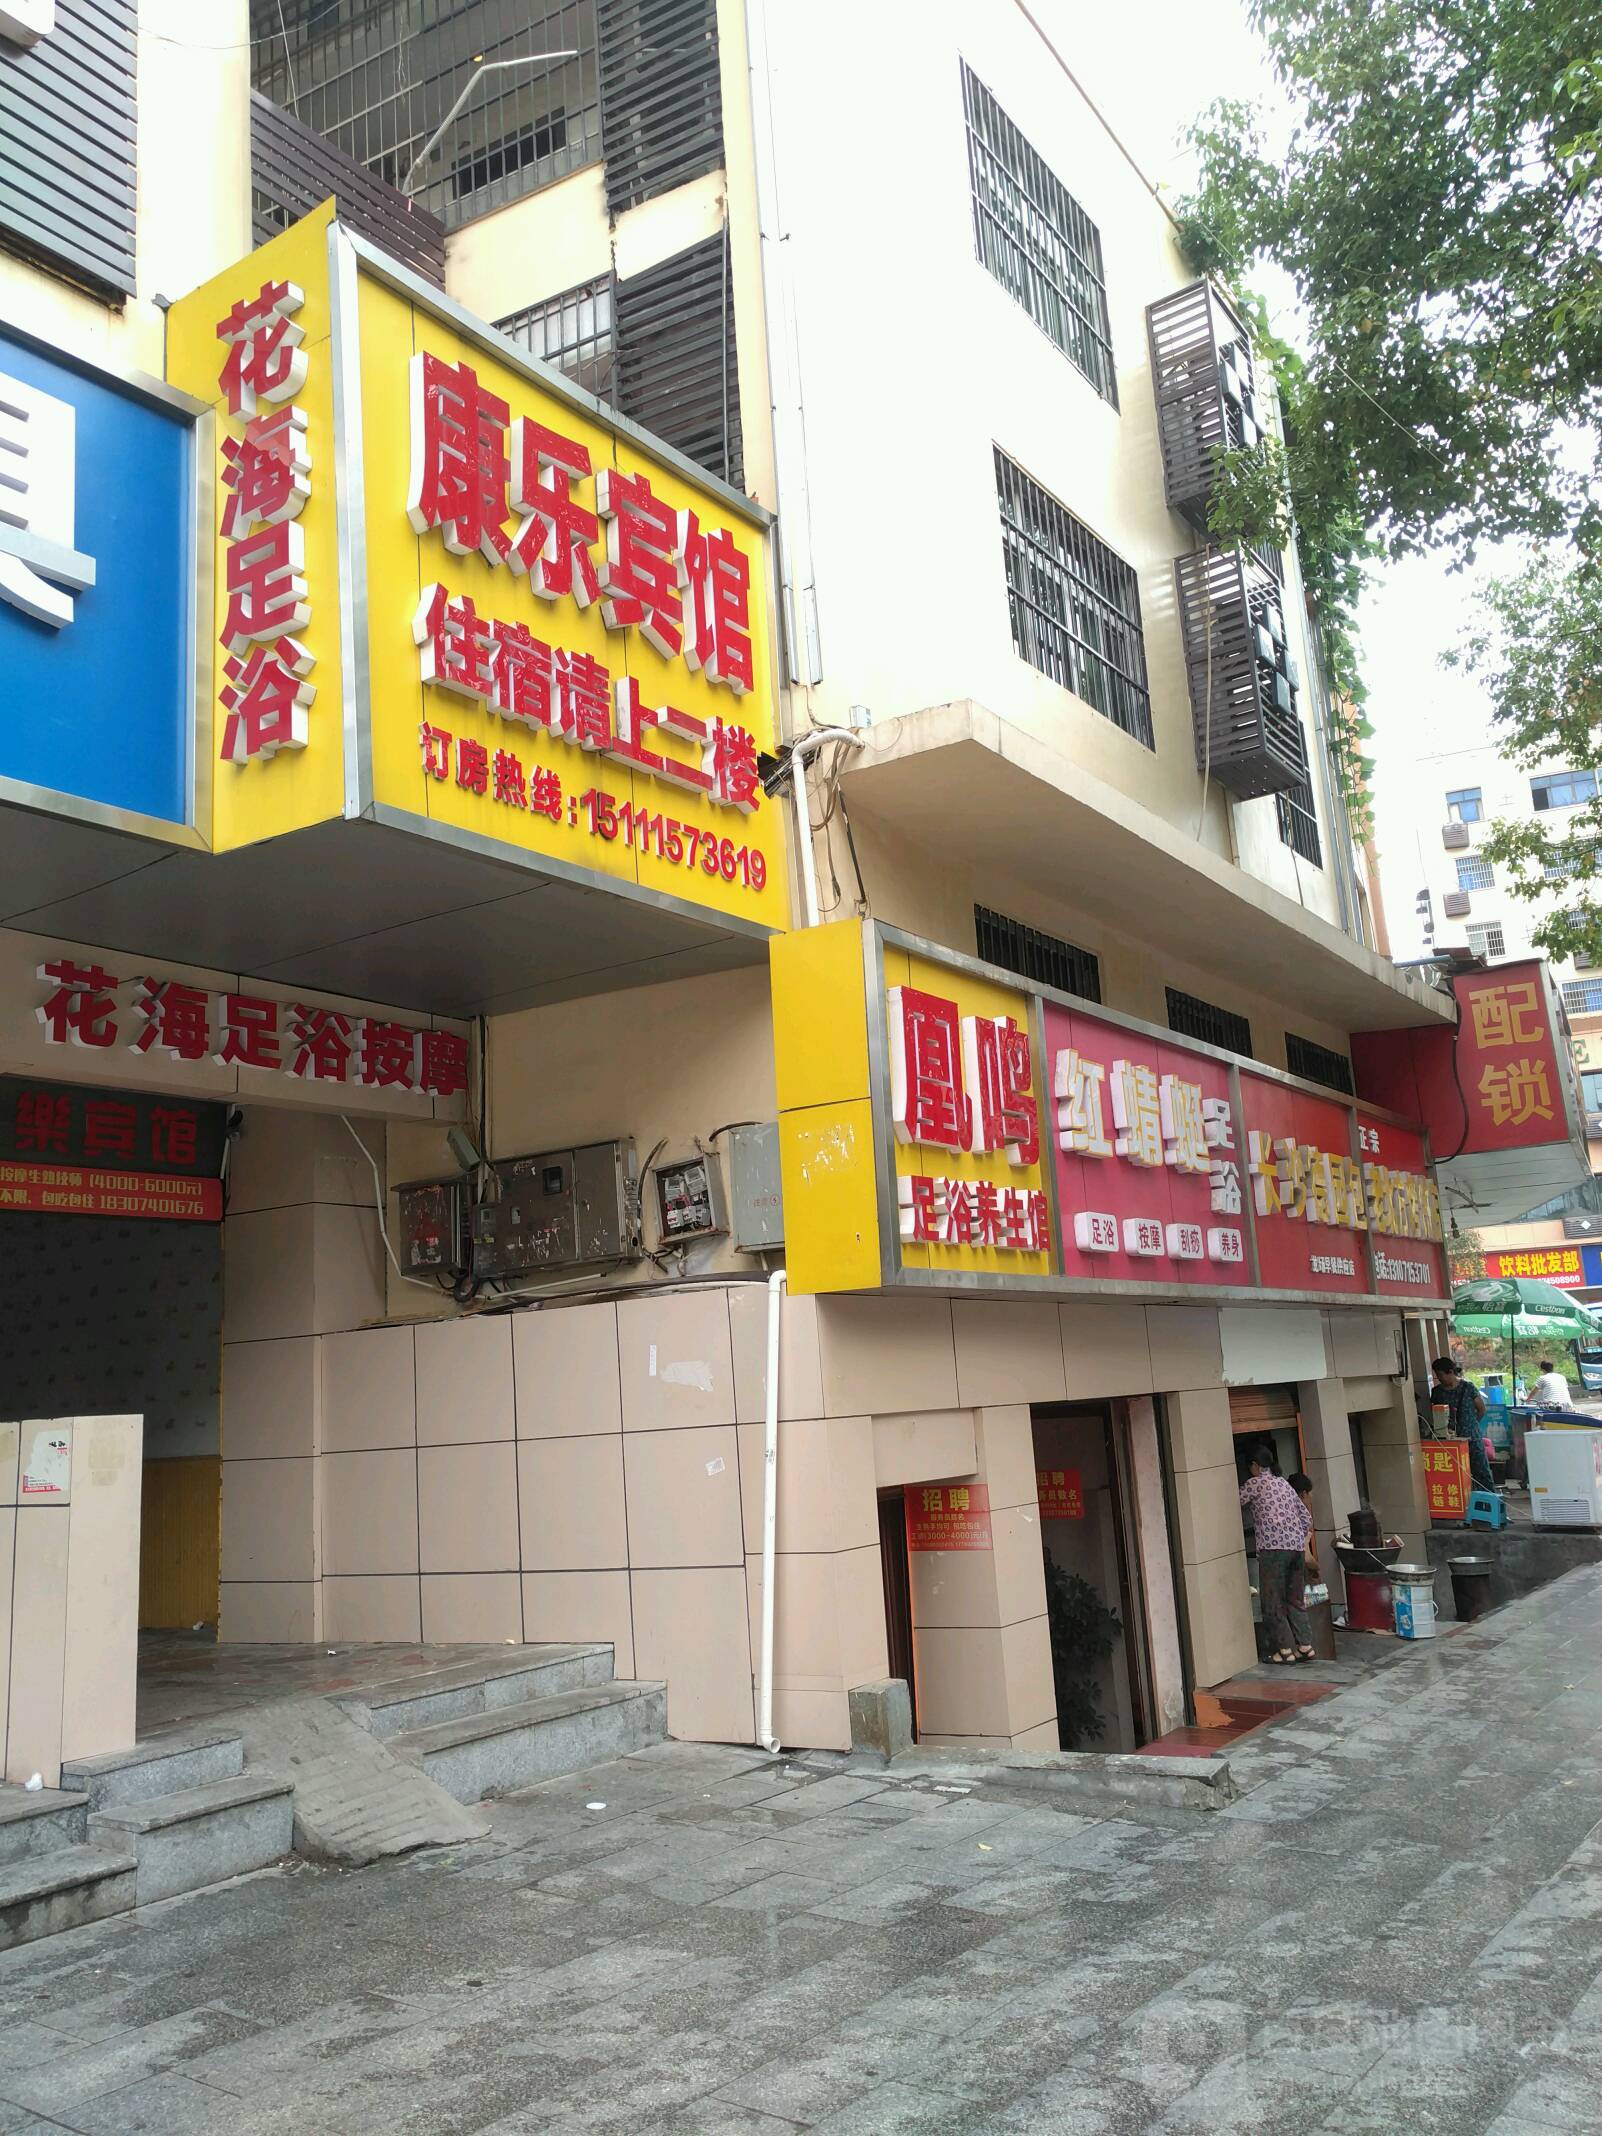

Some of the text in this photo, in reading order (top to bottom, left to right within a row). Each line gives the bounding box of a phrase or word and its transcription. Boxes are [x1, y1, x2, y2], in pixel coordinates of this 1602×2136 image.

[216, 280, 316, 766] 花海足浴
[407, 350, 756, 697] 康乐宾馆
[411, 582, 762, 814] 住宿请上二楼
[420, 722, 768, 891] 订房热线:15111573619
[35, 958, 470, 1097] 花海足浴按摩
[1468, 982, 1554, 1126] 配锁
[1055, 1048, 1212, 1175] 红蜻蜓
[1202, 1097, 1242, 1215] 足浴
[1358, 1126, 1380, 1153] 正宗
[101, 1195, 204, 1215] 18307401676
[898, 1175, 1050, 1252] 足浴养生馆
[1091, 1218, 1239, 1257] 足浴 按摩 刮痧 养身
[1499, 1251, 1580, 1277] 饮料批发部
[922, 1487, 970, 1512] 招聘
